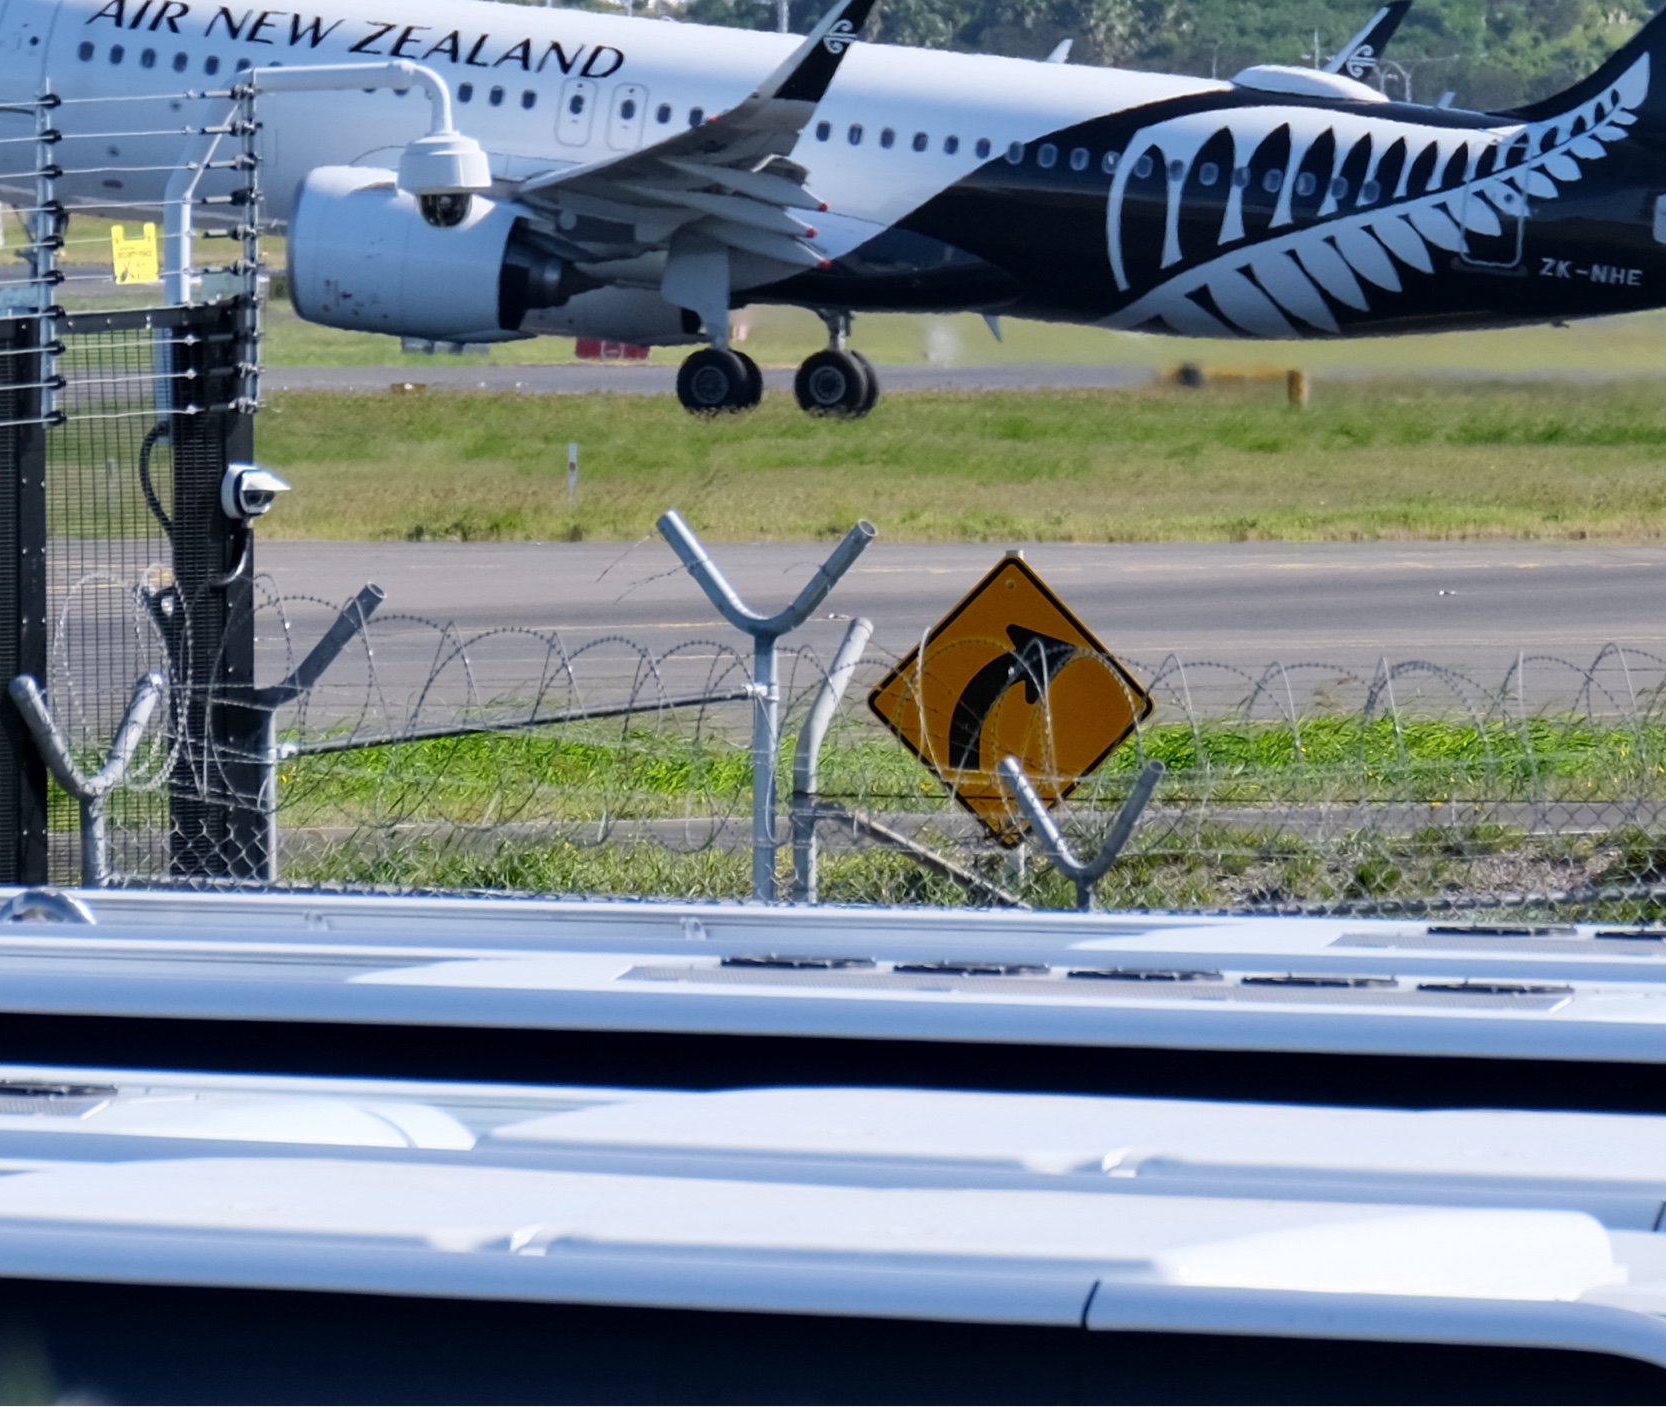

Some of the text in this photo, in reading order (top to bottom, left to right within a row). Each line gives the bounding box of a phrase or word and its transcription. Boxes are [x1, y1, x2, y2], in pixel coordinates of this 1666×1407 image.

[204, 5, 345, 48] NEW
[348, 20, 625, 79] ZEALAND
[1539, 257, 1643, 286] ZK-NHE
